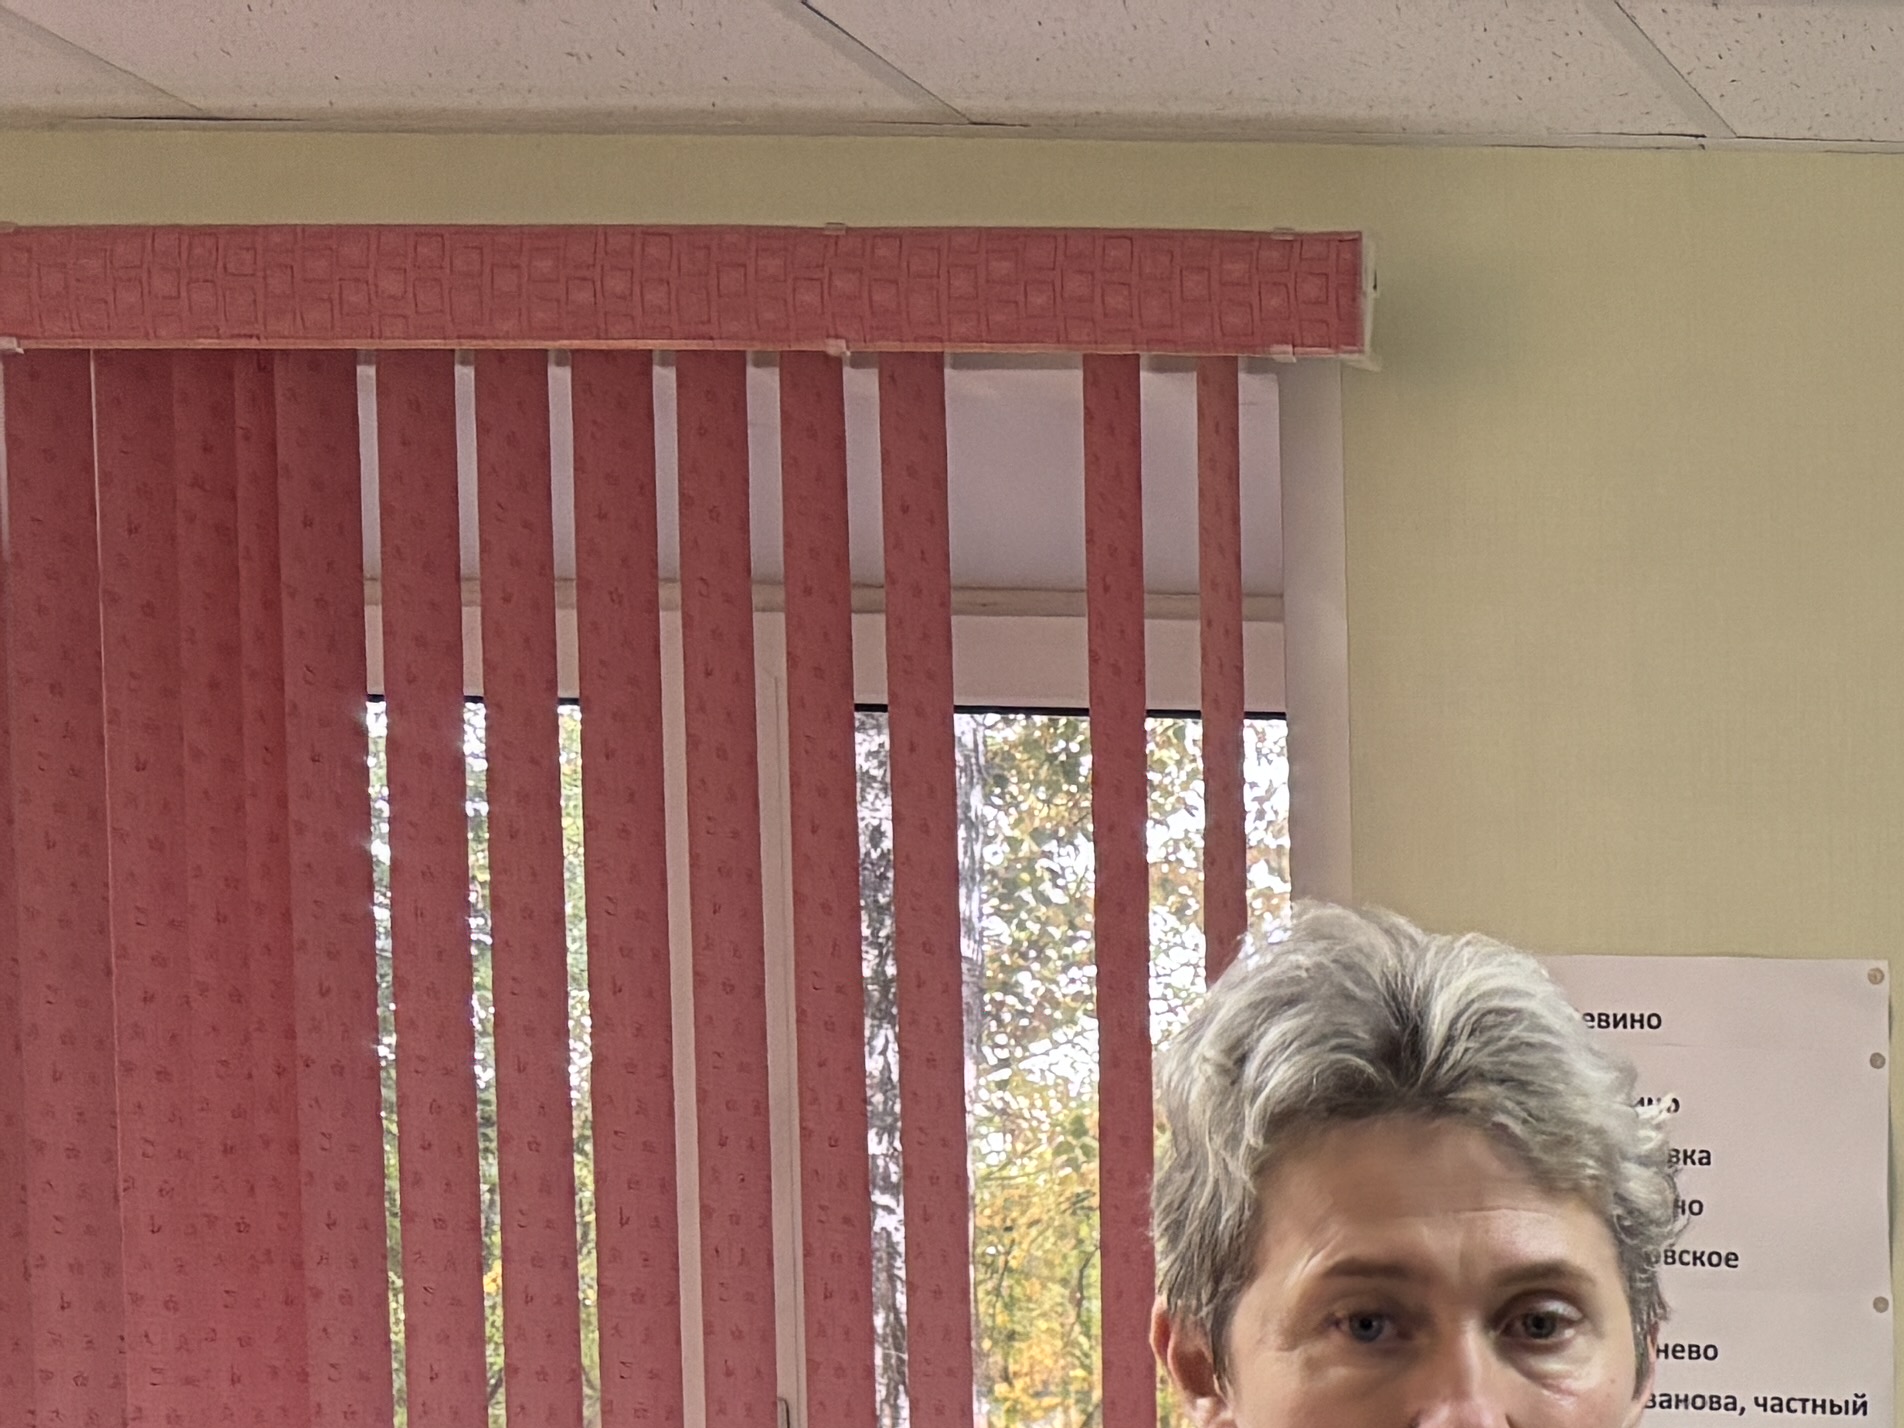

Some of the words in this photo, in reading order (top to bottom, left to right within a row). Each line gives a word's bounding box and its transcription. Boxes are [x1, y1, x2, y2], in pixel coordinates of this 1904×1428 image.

[1582, 1012, 1662, 1030] евино
[1667, 1148, 1712, 1167] вка
[1656, 1343, 1719, 1361] нево
[1645, 1393, 1747, 1416] ванова,
[1754, 1394, 1868, 1416] частный
